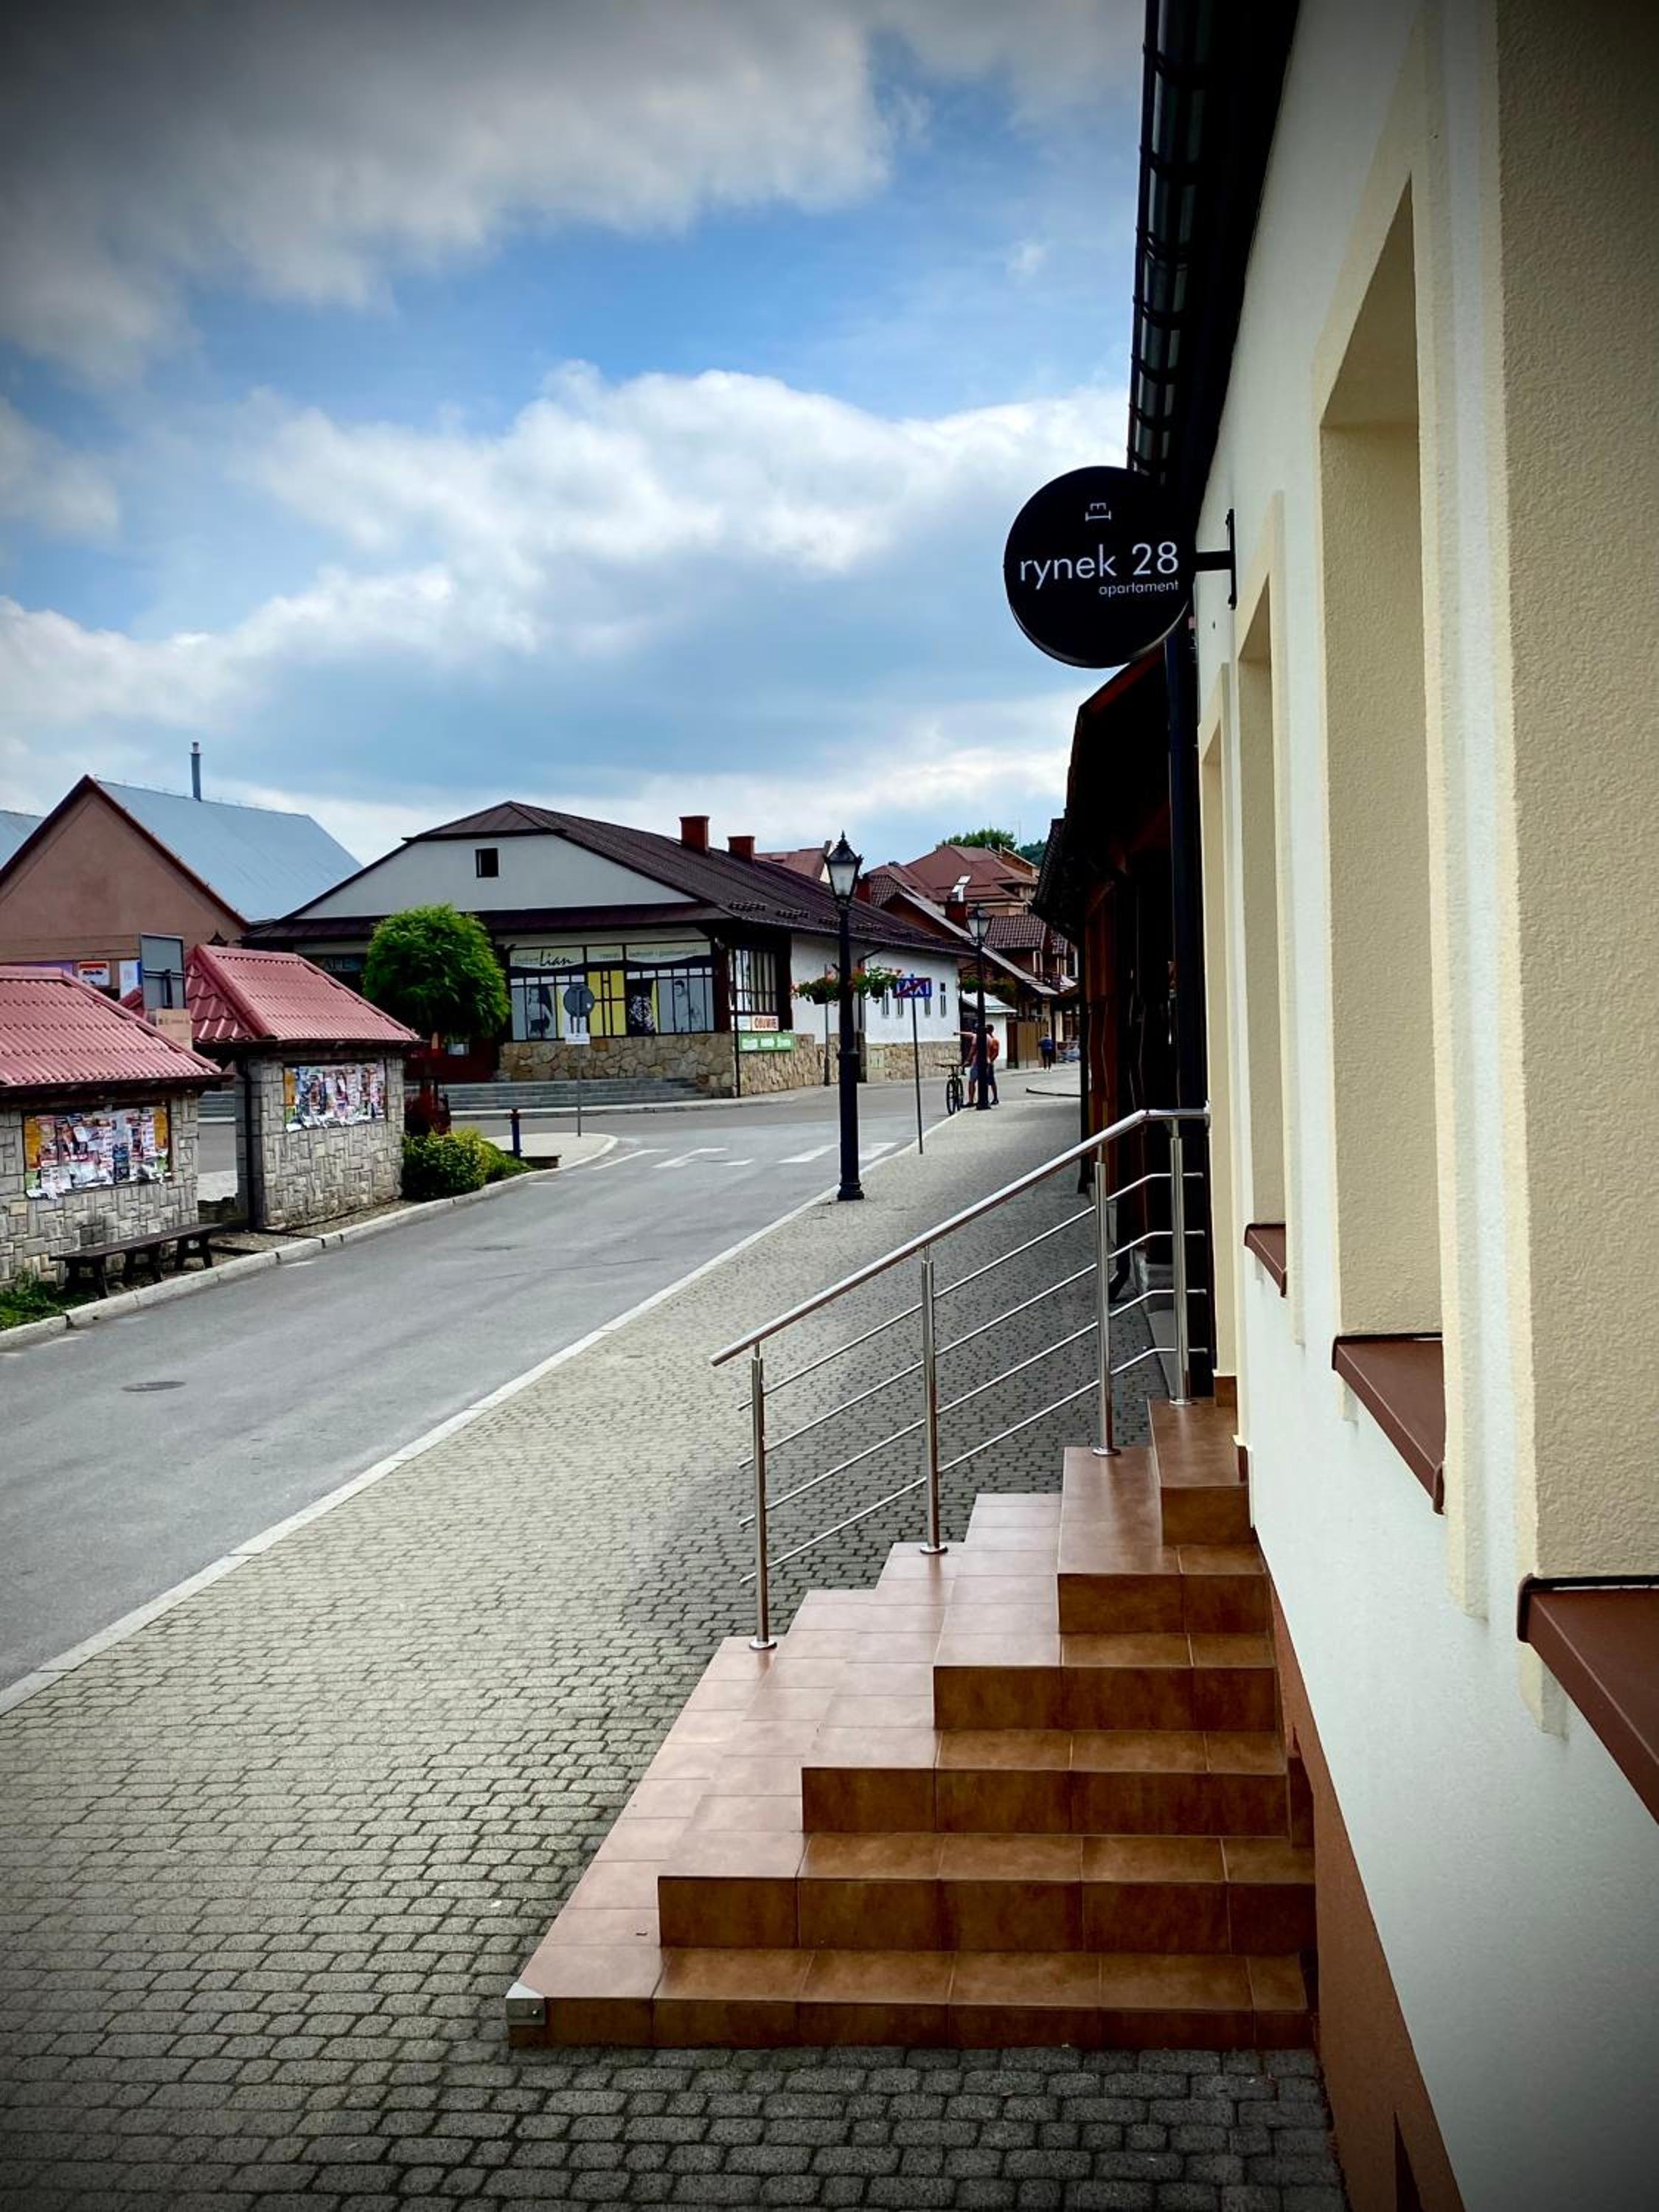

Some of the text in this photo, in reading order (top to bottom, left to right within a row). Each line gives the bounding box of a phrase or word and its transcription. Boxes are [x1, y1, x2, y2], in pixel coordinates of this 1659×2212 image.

[1020, 541, 1179, 590] rynek 28
[1098, 580, 1179, 598] apartament
[894, 980, 930, 995] TAXI
